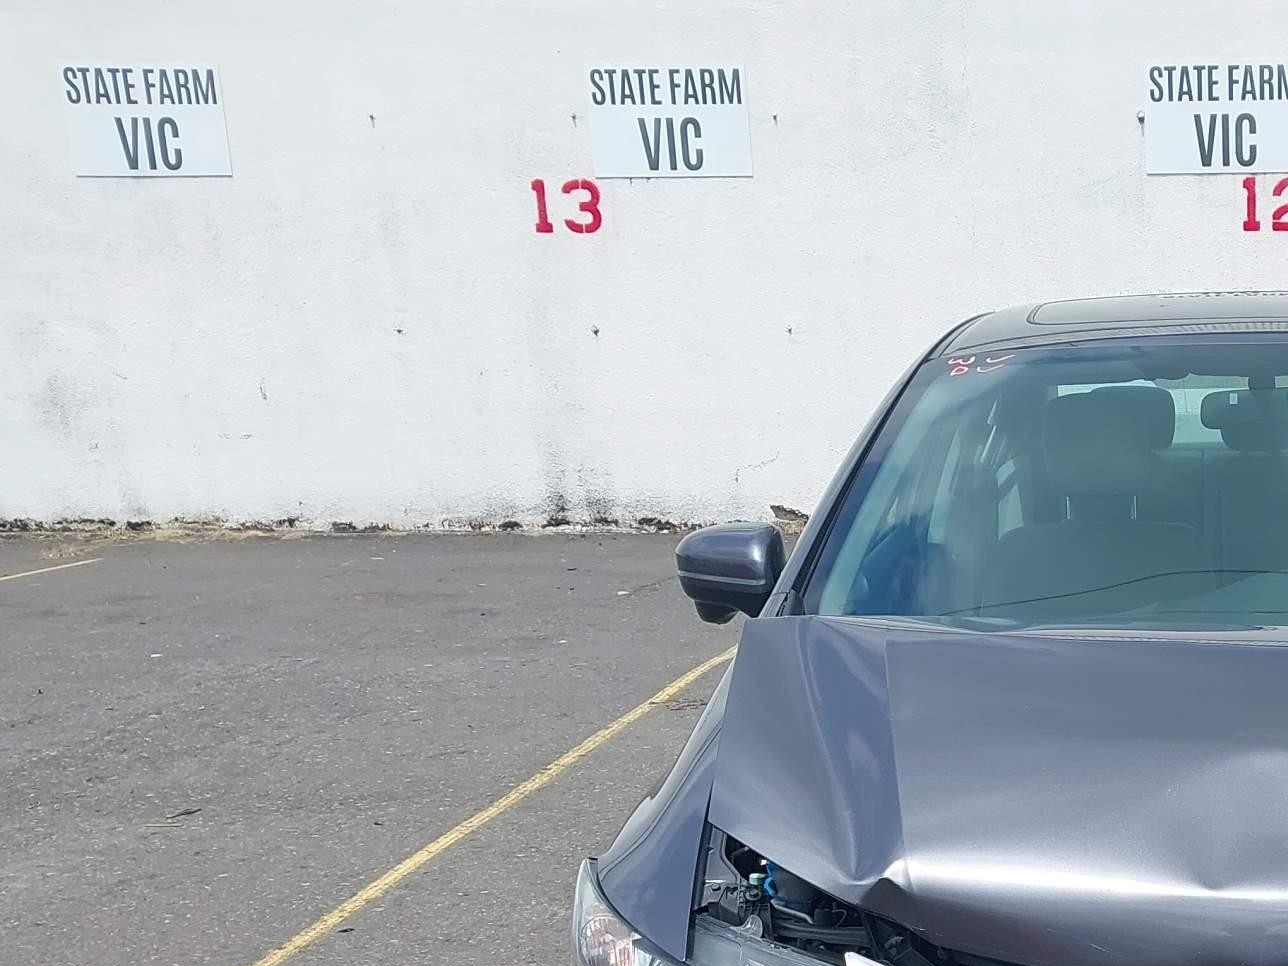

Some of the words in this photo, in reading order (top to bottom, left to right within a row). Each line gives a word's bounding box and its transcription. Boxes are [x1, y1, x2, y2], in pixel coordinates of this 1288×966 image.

[63, 66, 138, 105] STATE
[142, 68, 218, 105] FARM
[590, 69, 663, 106] STATE
[668, 68, 742, 105] FARM
[1149, 65, 1220, 103] STATE
[114, 117, 183, 171] VIC
[637, 117, 704, 171] VIC
[1193, 112, 1257, 168] VIC
[531, 179, 603, 234] 13
